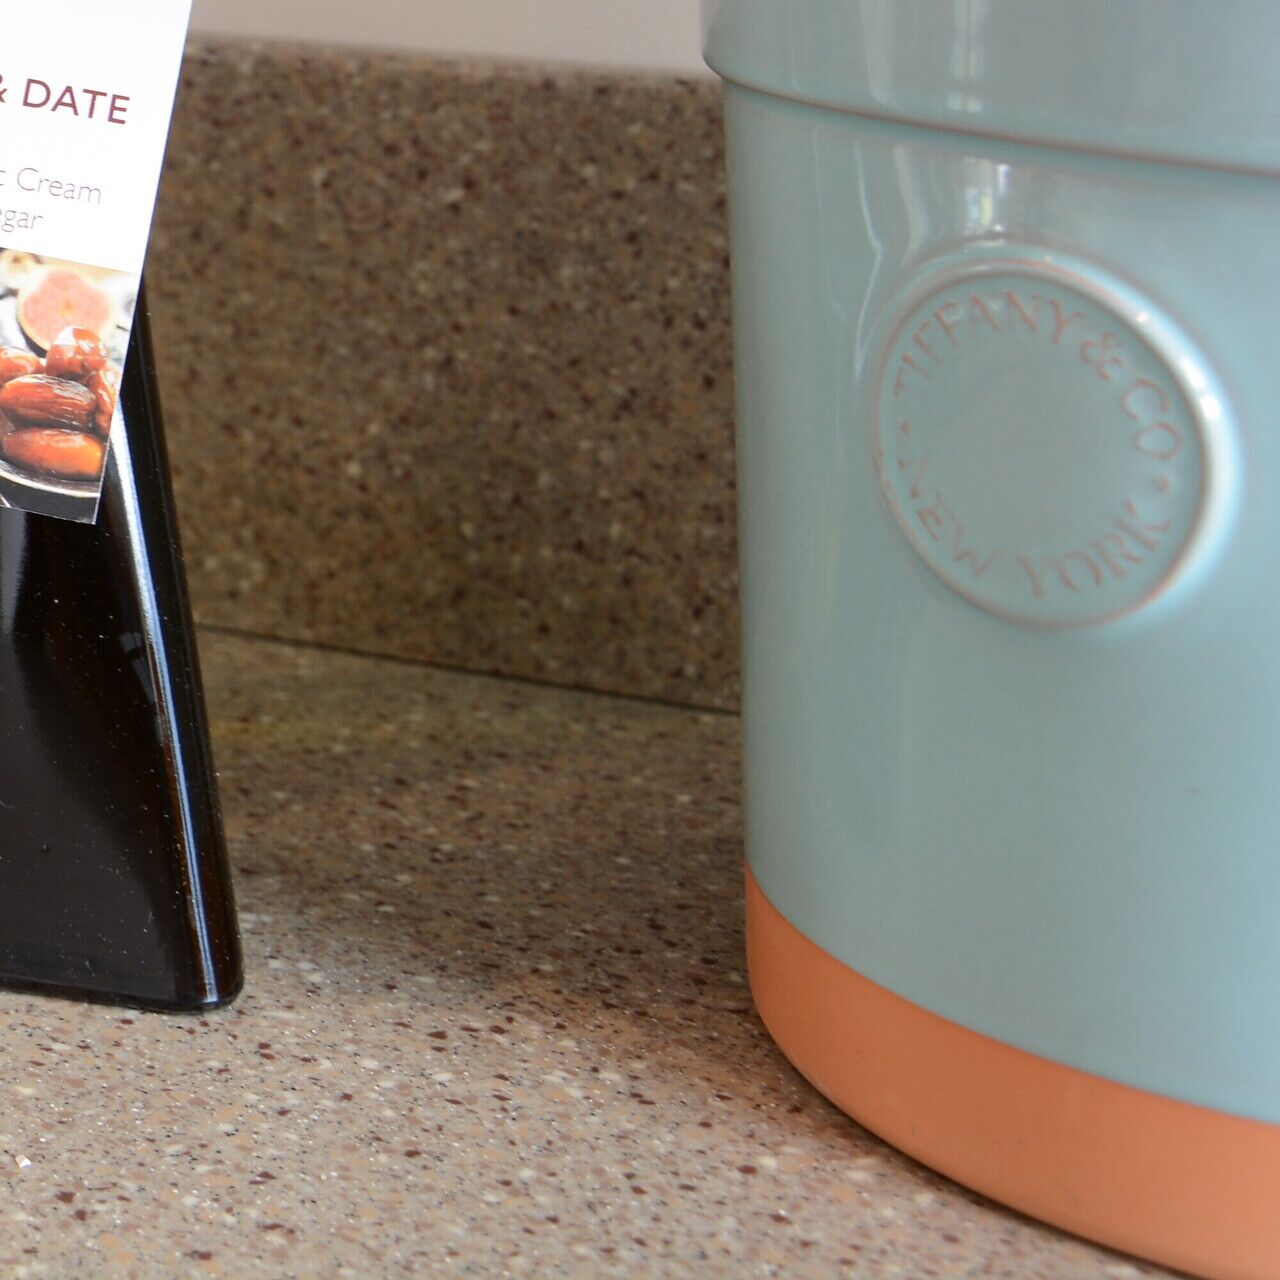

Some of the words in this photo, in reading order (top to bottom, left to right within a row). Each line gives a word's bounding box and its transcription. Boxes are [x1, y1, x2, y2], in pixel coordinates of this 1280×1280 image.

[22, 78, 131, 125] DATE
[16, 167, 102, 204] Cream
[893, 288, 1088, 401] TIFFANY
[1080, 331, 1125, 381] &
[1016, 496, 1172, 599] YORK
